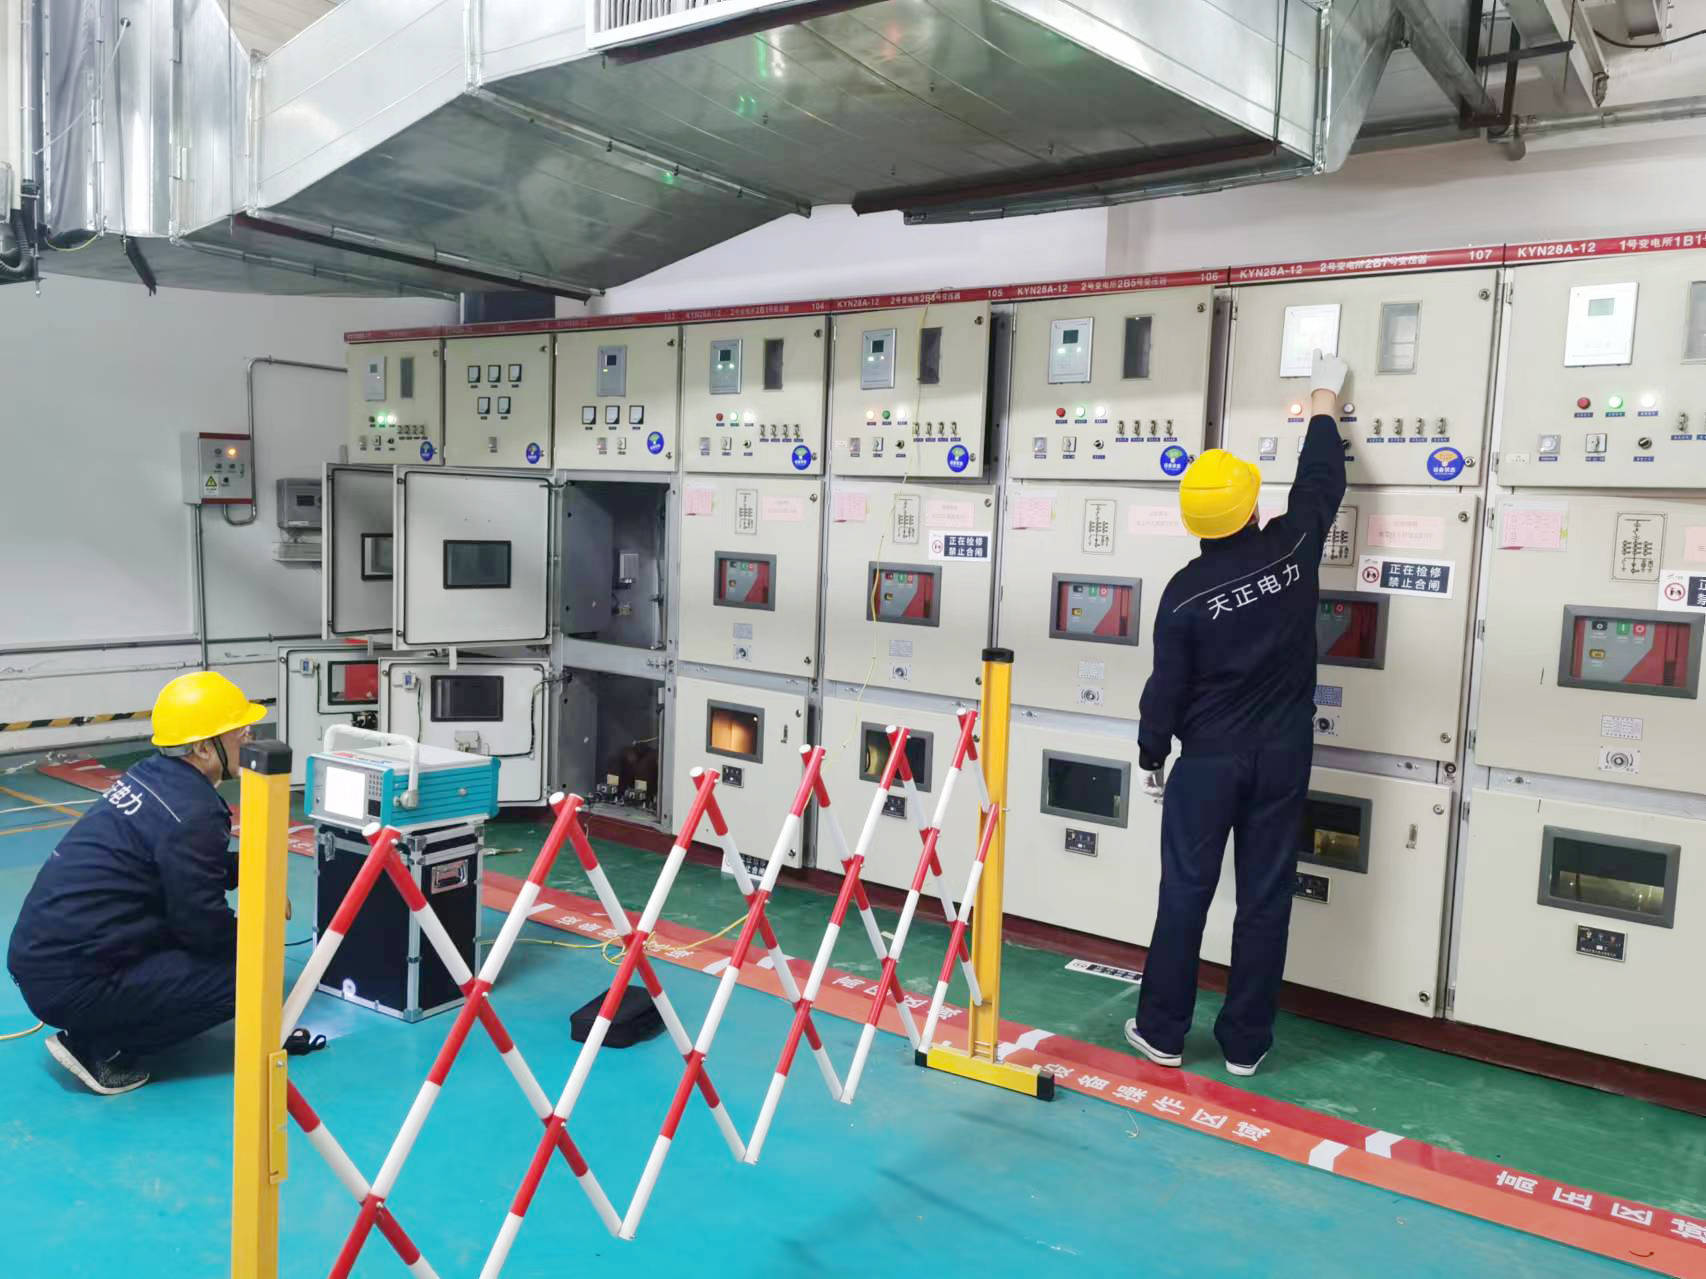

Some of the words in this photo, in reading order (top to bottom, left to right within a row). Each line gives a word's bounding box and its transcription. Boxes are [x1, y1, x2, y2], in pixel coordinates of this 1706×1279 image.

[1517, 242, 1596, 257] KYN28A-12
[1240, 264, 1303, 278] KYN28A-12
[1469, 249, 1493, 260] 107
[1017, 283, 1069, 296] KYN28A-12
[1200, 271, 1219, 281] 106
[949, 536, 983, 546] 正在检修
[1389, 563, 1442, 578] 正在检修
[1388, 576, 1440, 591] 禁止合闸
[1207, 563, 1300, 620] 天正电力
